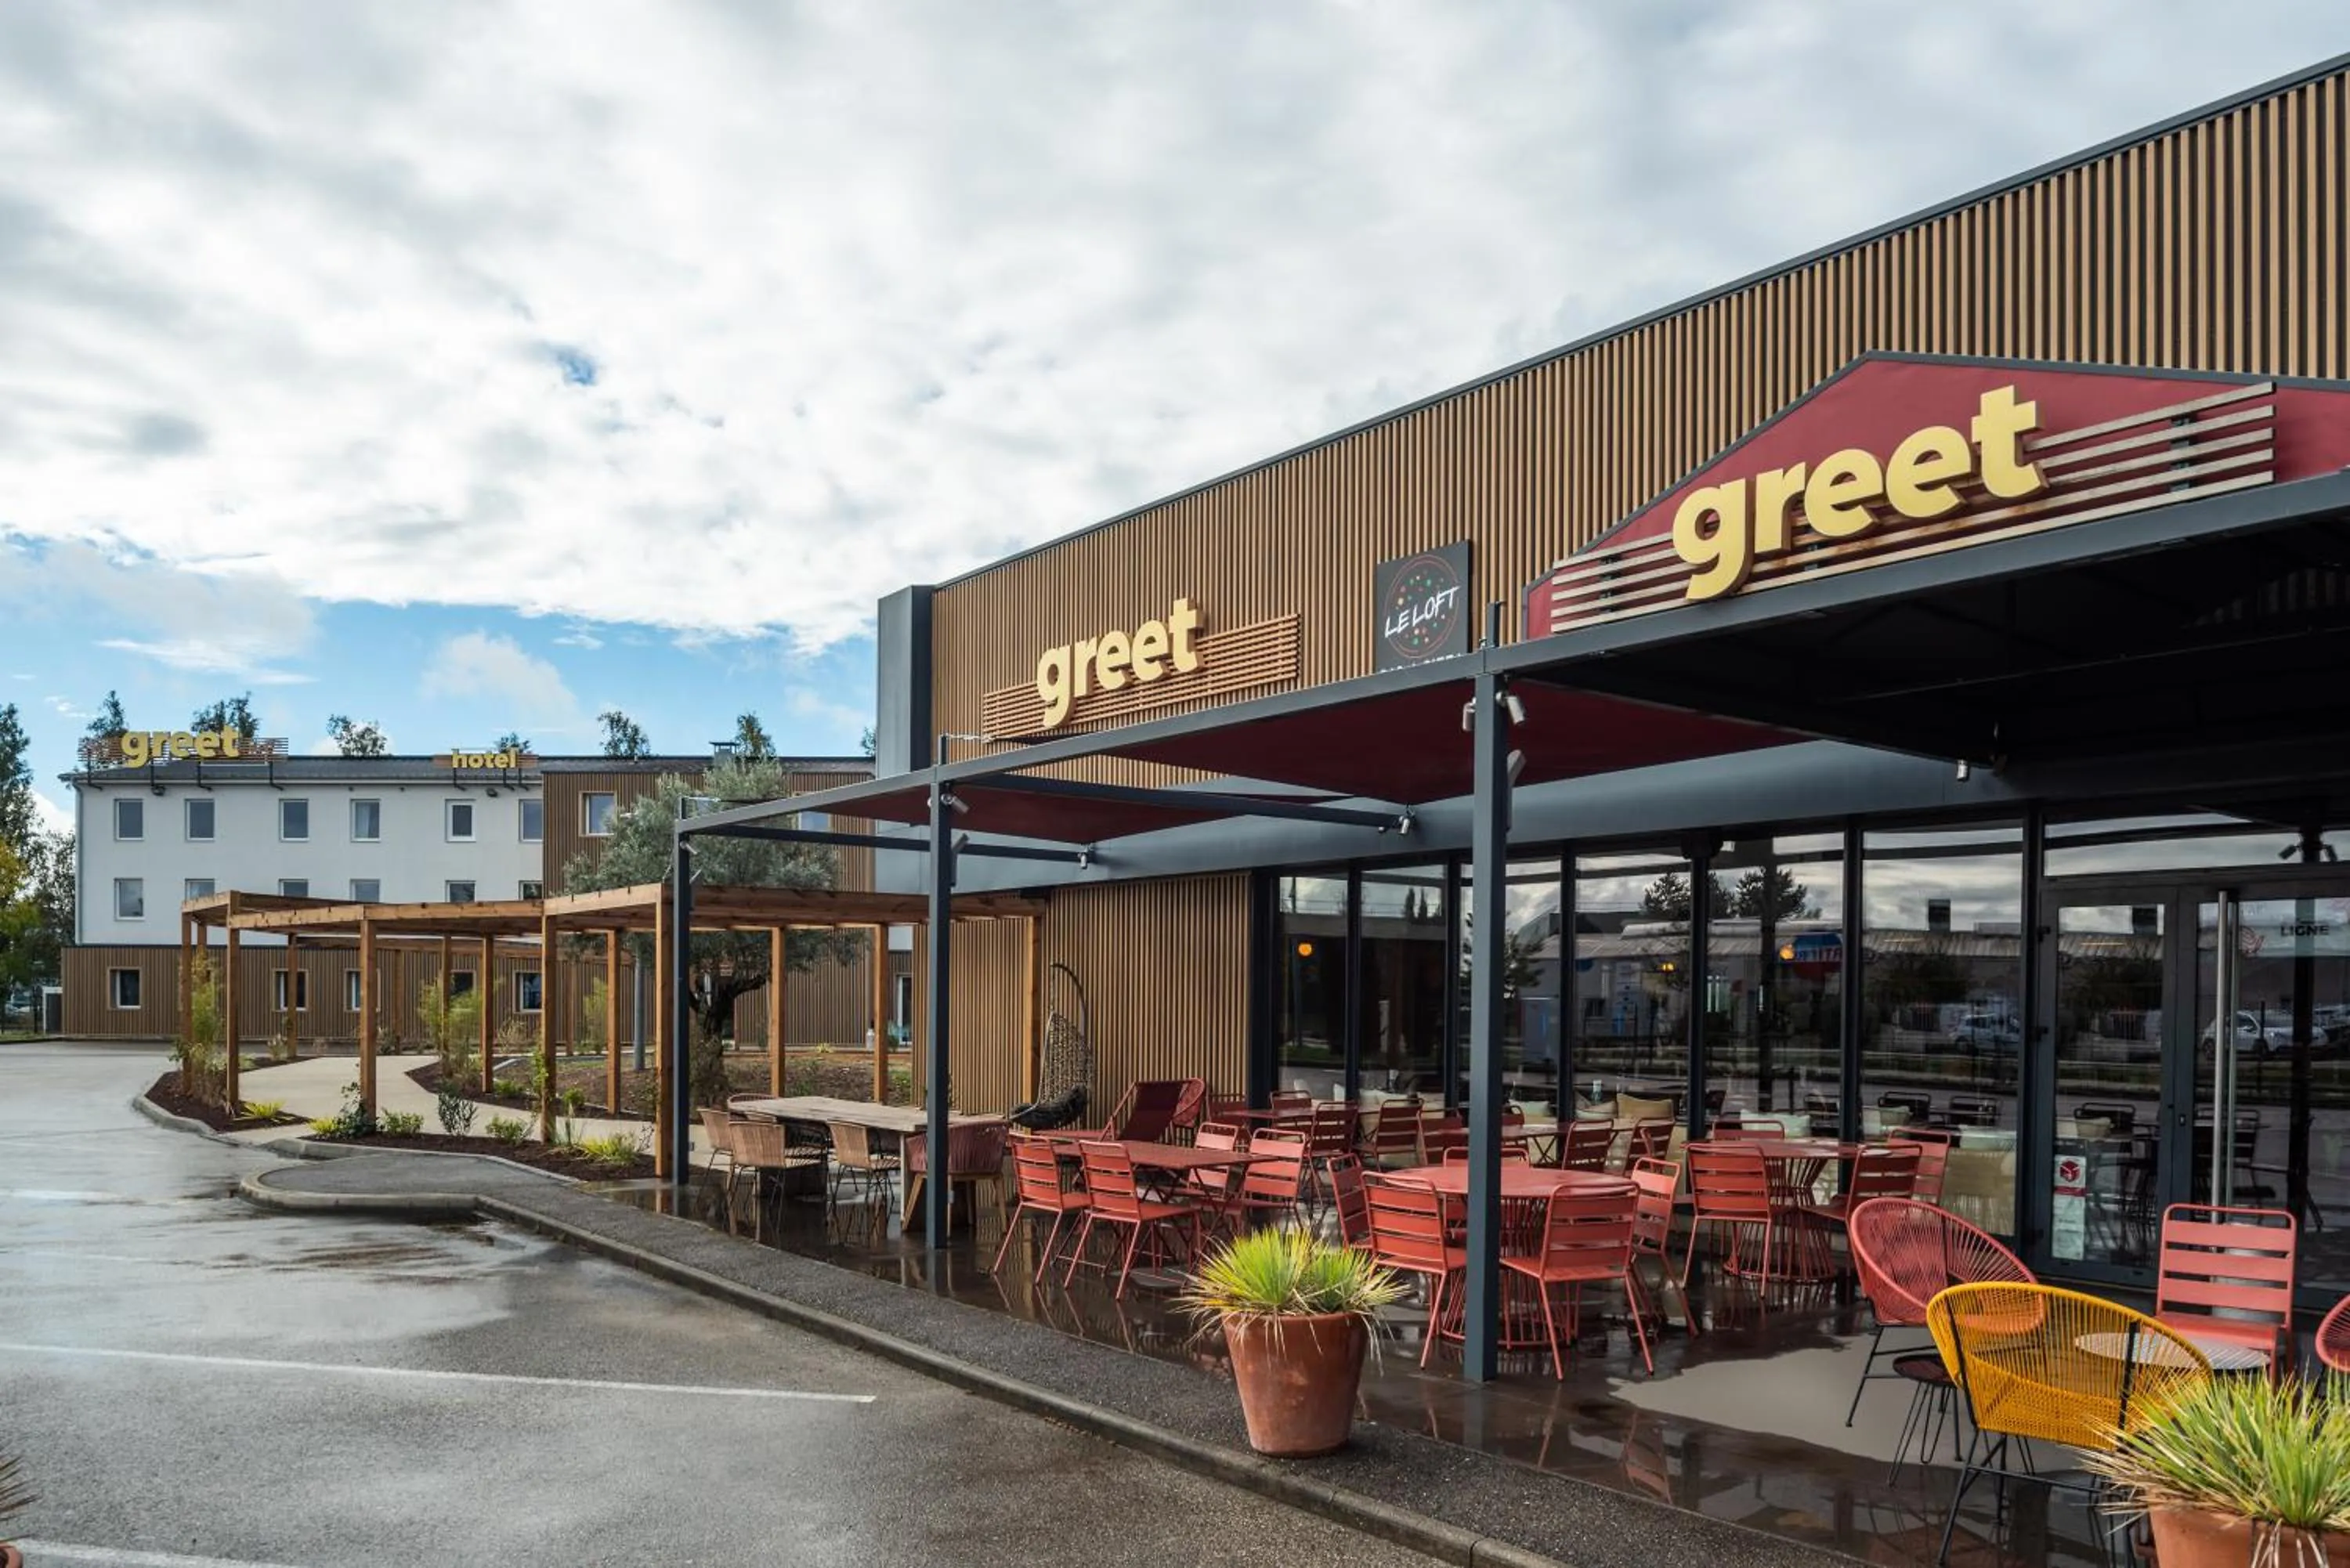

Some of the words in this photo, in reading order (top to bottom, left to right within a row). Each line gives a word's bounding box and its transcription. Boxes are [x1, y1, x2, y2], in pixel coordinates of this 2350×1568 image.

[1673, 385, 2043, 601] greet
[1384, 609, 1410, 638] LE
[1412, 586, 1462, 627] LOFT
[1037, 598, 1200, 728] greet
[121, 725, 239, 768] greet
[451, 748, 518, 768] hotel
